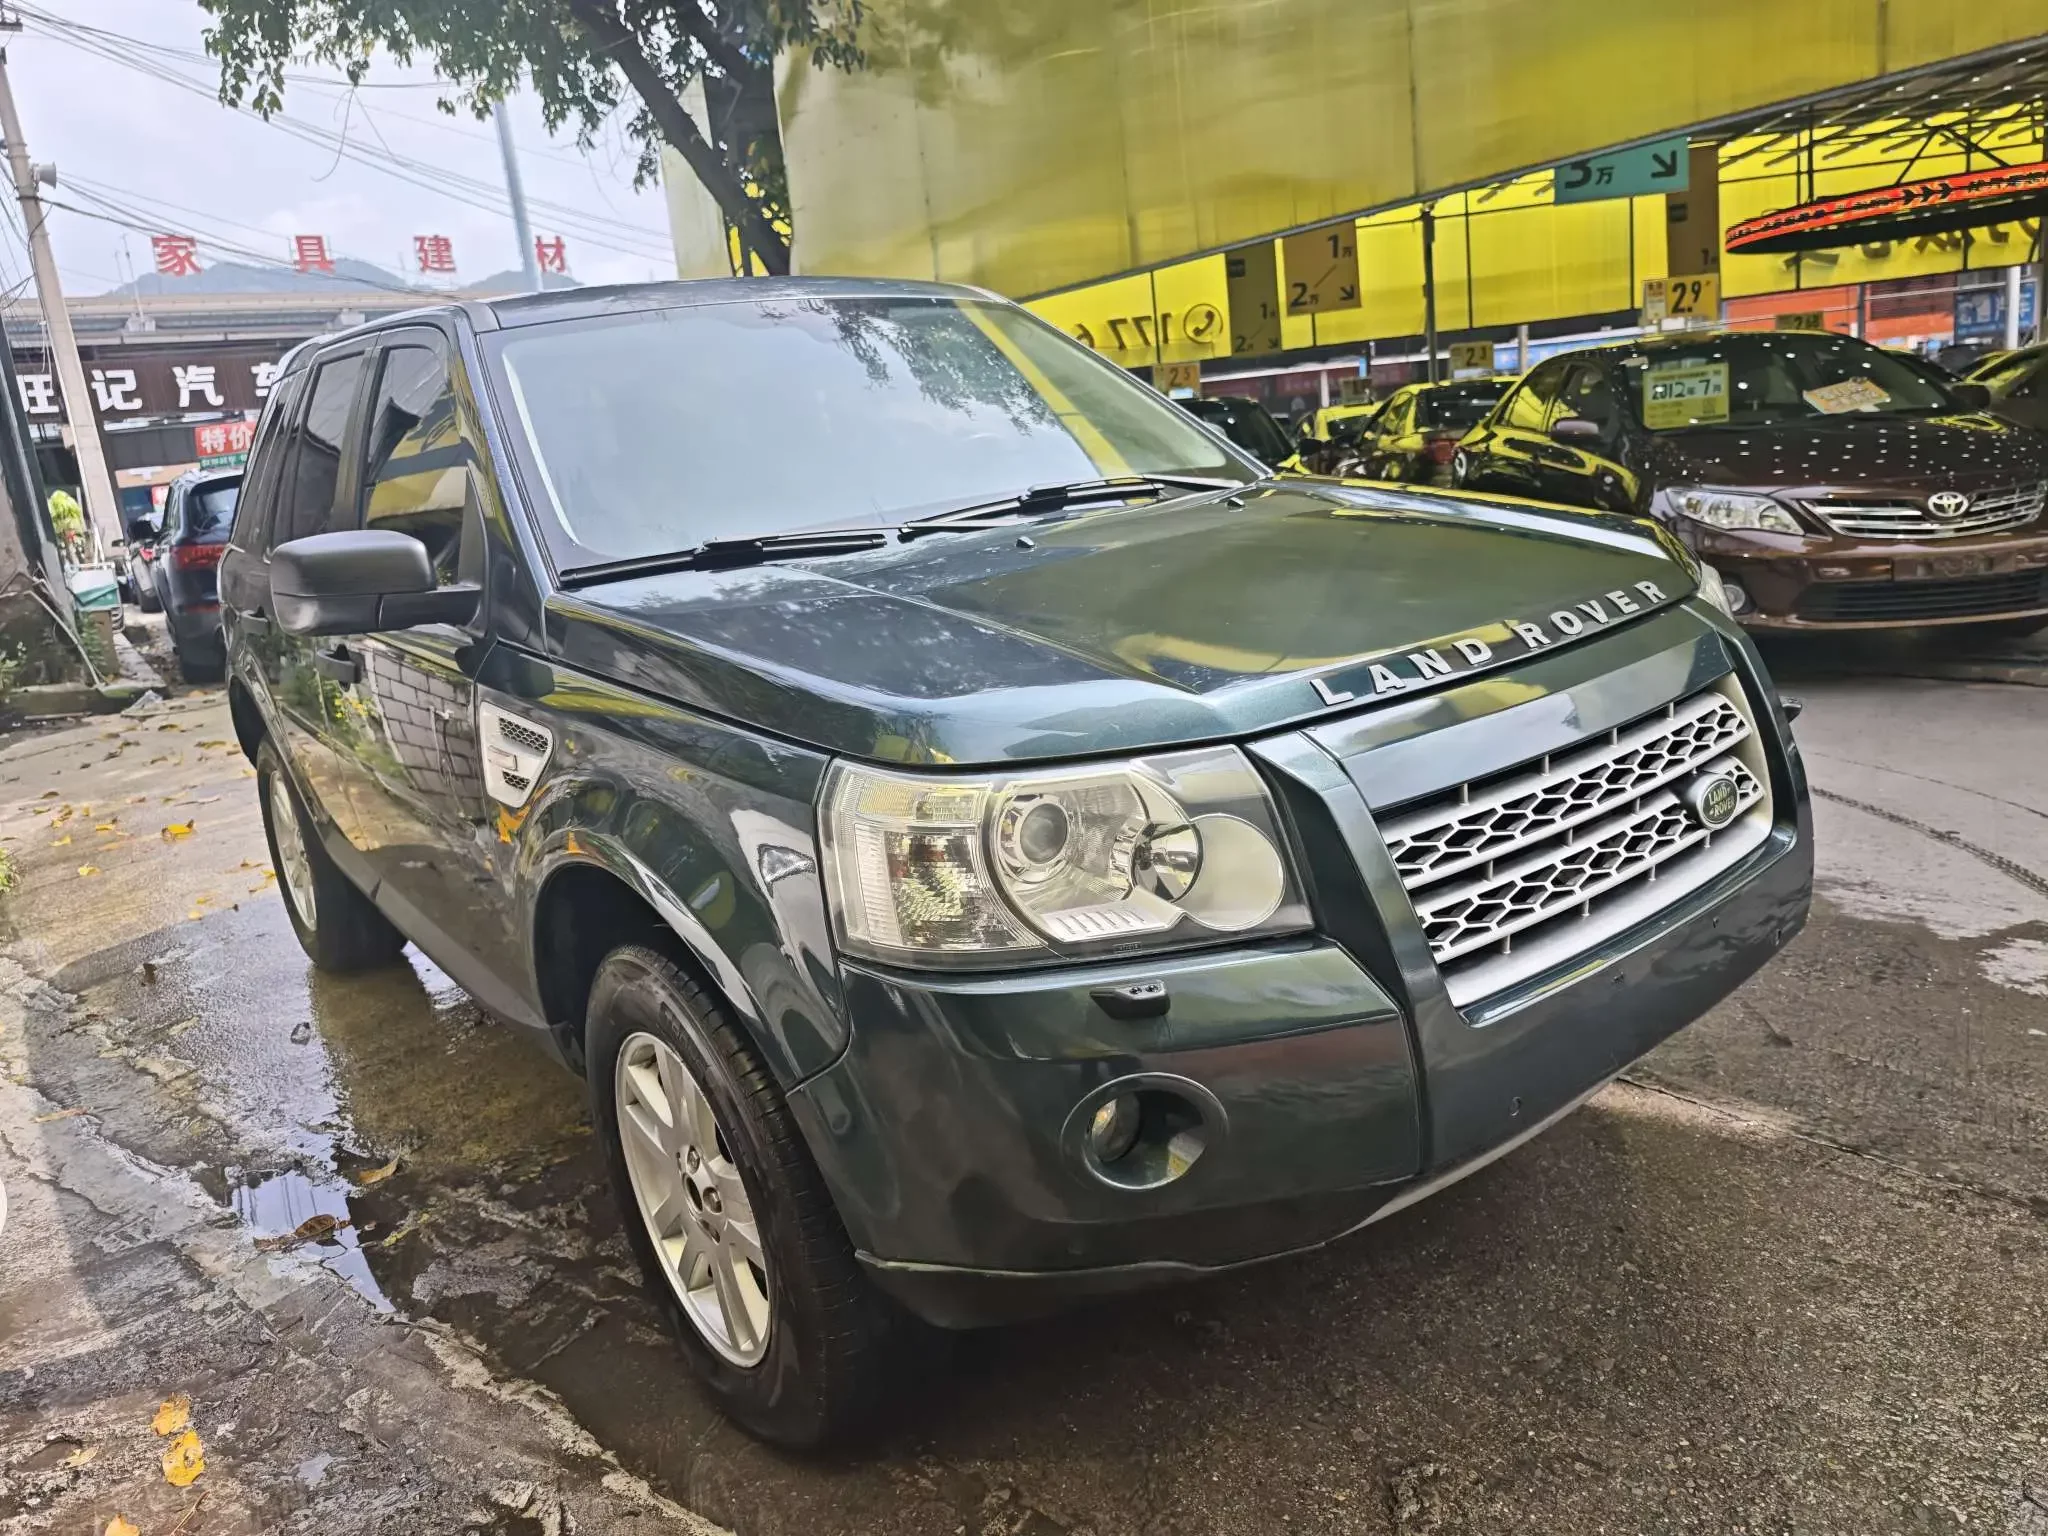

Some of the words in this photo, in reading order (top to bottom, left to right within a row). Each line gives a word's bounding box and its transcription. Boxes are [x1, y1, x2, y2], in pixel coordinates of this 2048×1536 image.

[151, 234, 566, 277] 家具建材
[1309, 638, 1494, 706] LAND
[1512, 580, 1668, 649] ROVER
[1708, 784, 1730, 806] LAND
[1714, 796, 1736, 817] ROVER
